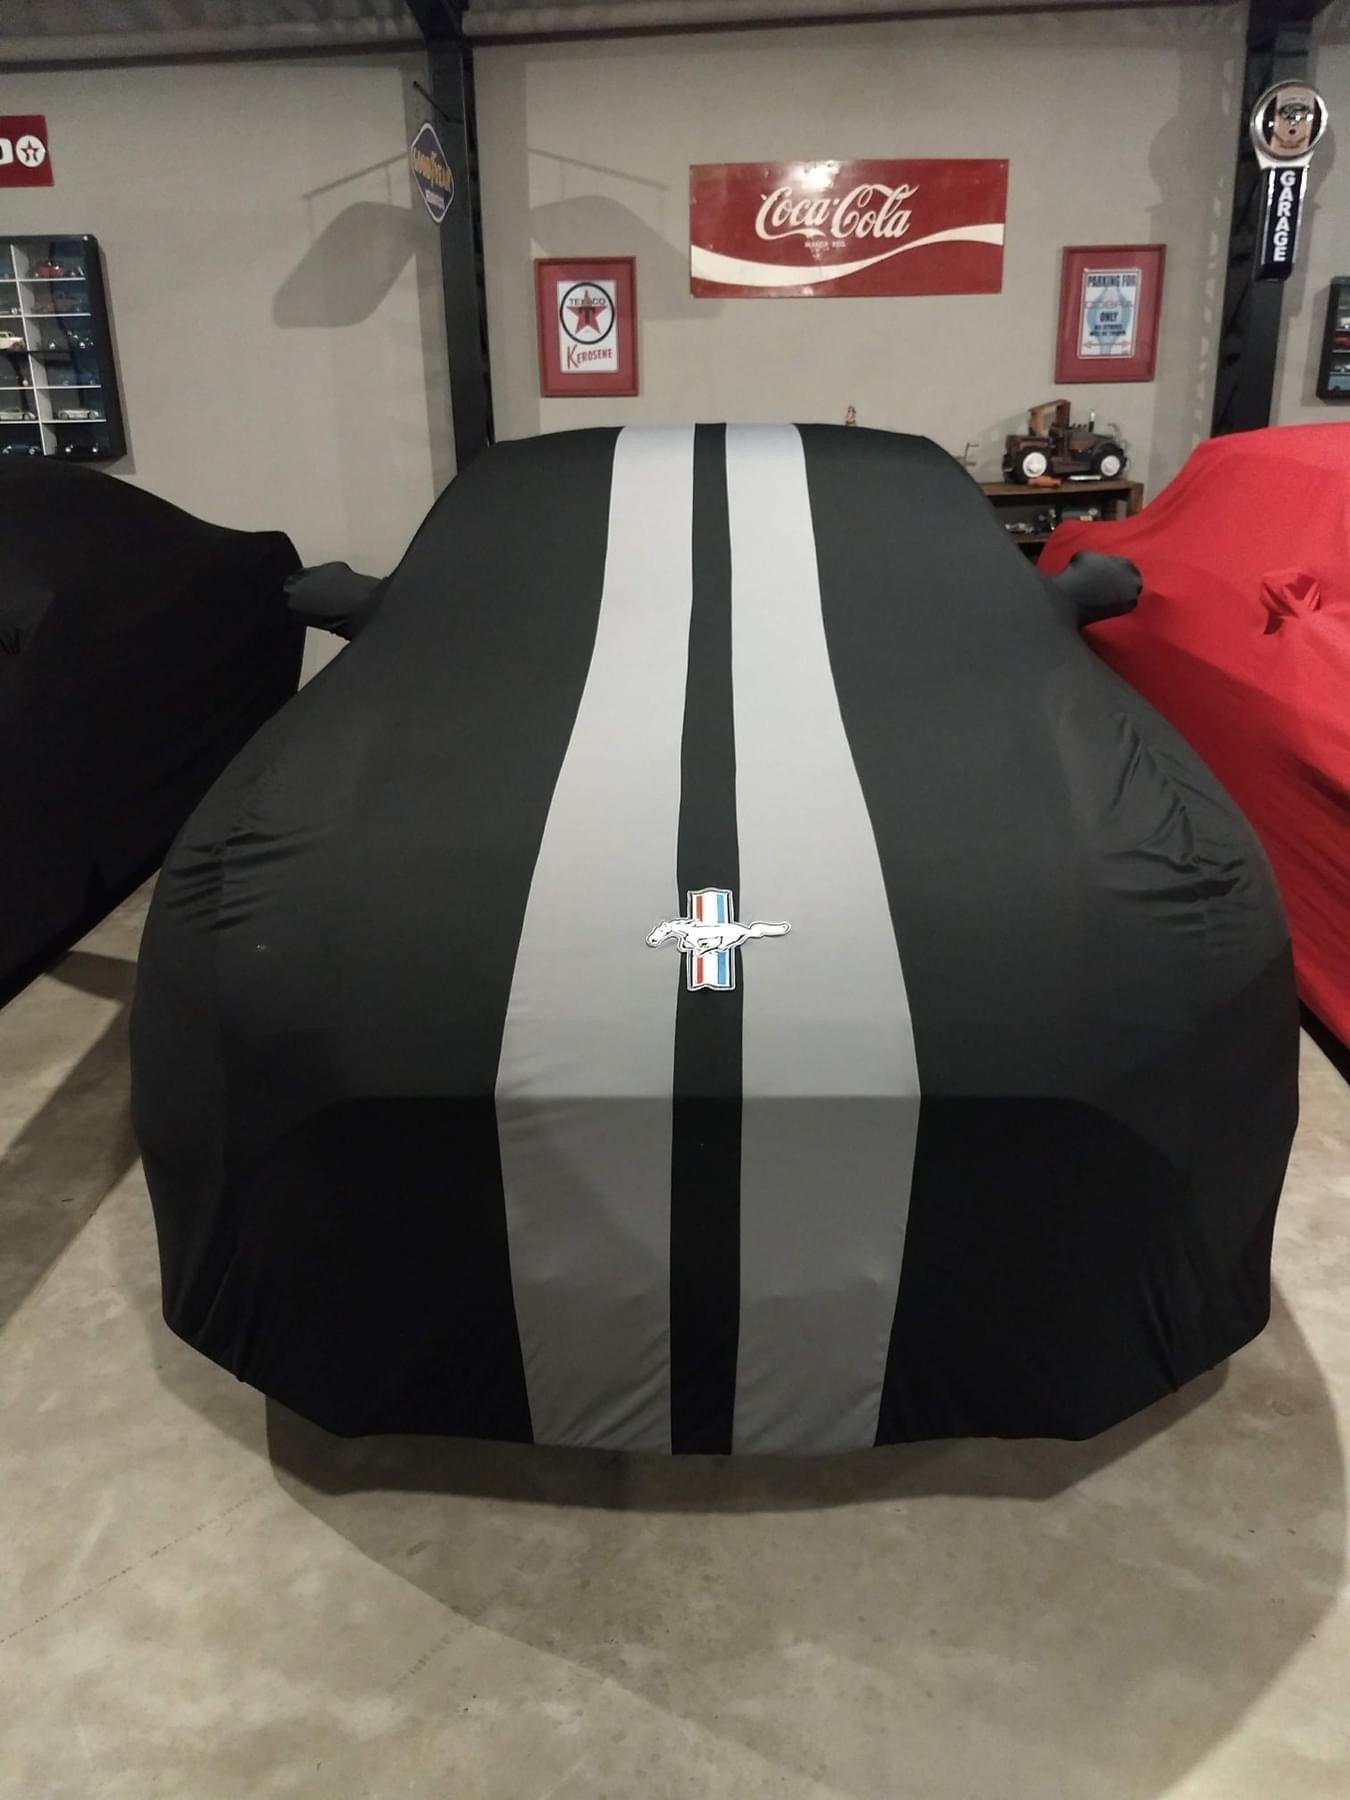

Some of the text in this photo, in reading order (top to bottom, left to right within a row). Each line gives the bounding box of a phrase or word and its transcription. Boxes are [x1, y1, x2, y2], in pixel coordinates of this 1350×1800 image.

[755, 184, 920, 240] Coca-Cola
[1273, 170, 1297, 262] GARAGE
[1088, 274, 1137, 288] PARKING FOR
[569, 298, 606, 306] TECO
[1100, 311, 1118, 322] ONLY
